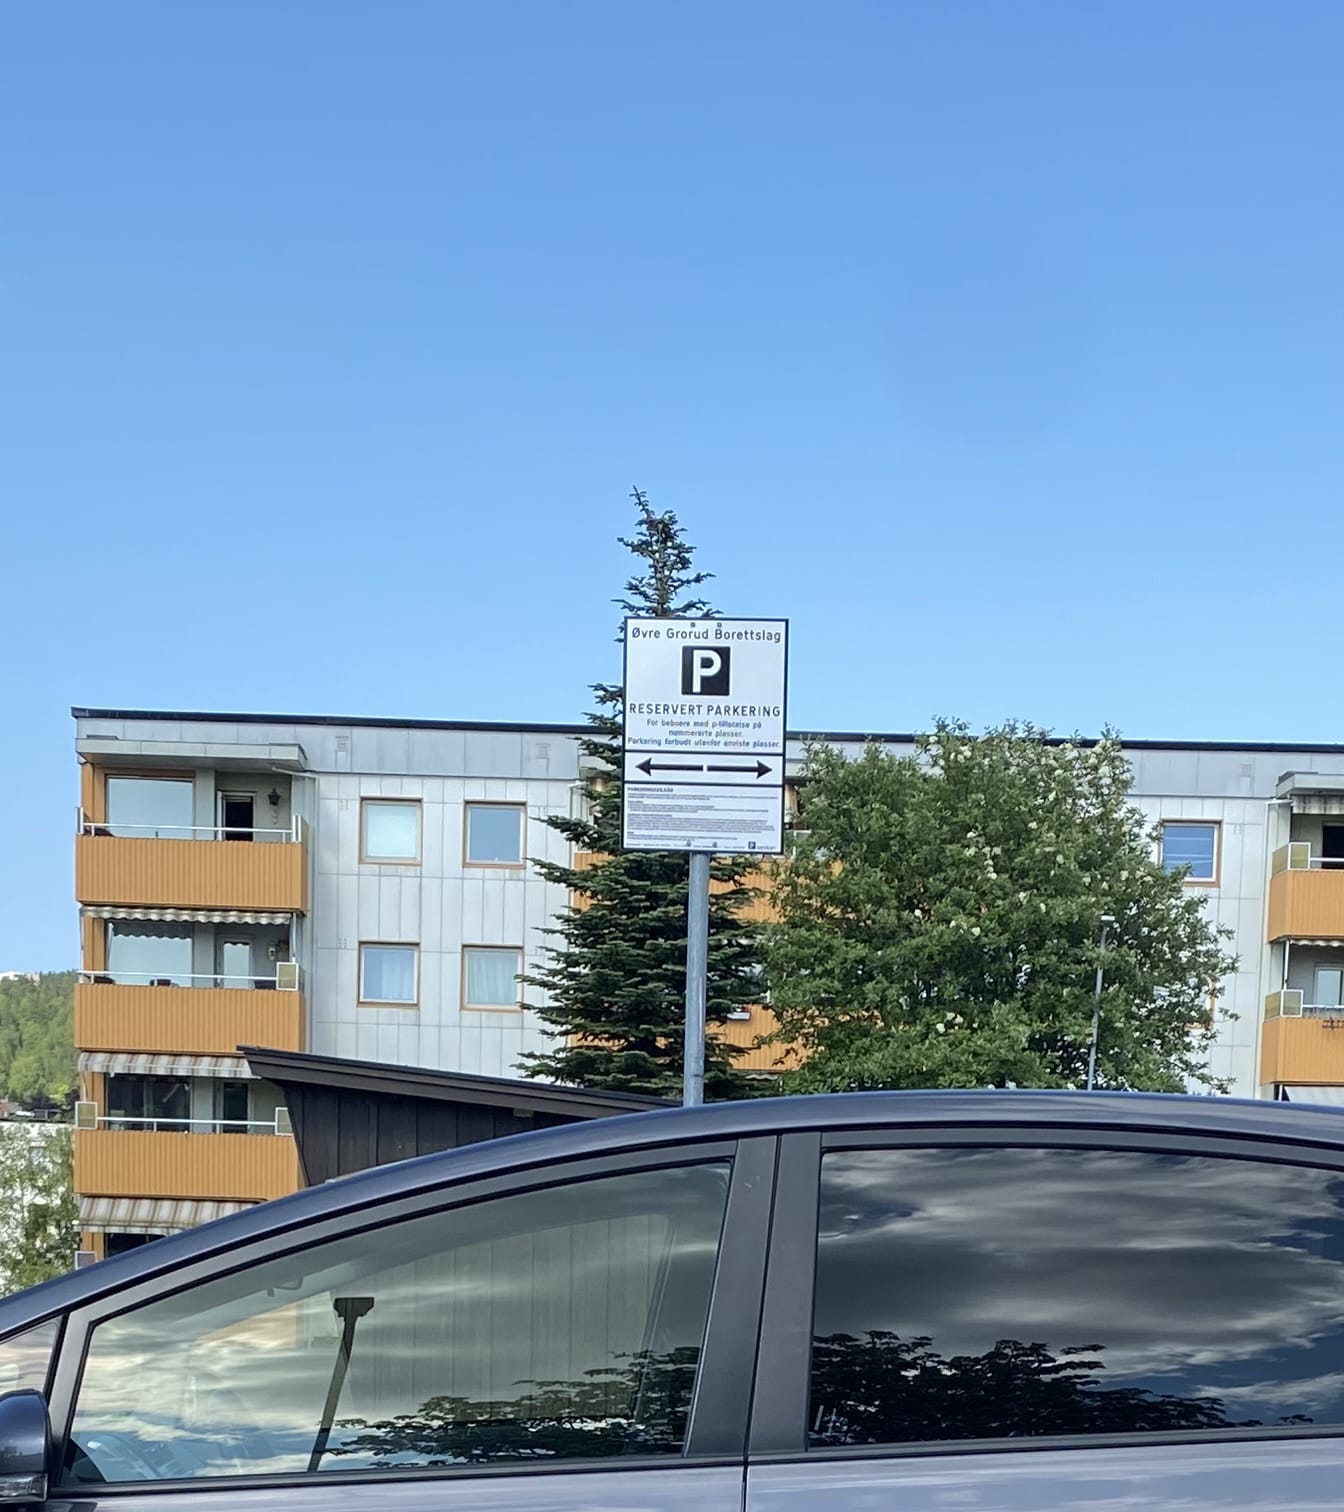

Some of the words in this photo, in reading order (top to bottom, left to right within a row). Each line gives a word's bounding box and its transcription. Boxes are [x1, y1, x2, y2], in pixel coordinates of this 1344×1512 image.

[632, 627, 661, 639] Øvre
[666, 628, 709, 640] Grorud
[715, 628, 781, 644] Borettslag
[692, 649, 722, 693] P
[629, 703, 703, 715] RESERVERT
[707, 705, 781, 717] PARKERING
[646, 719, 658, 727] For
[693, 720, 709, 728] med
[752, 721, 762, 730] på
[627, 736, 662, 747] Parkering
